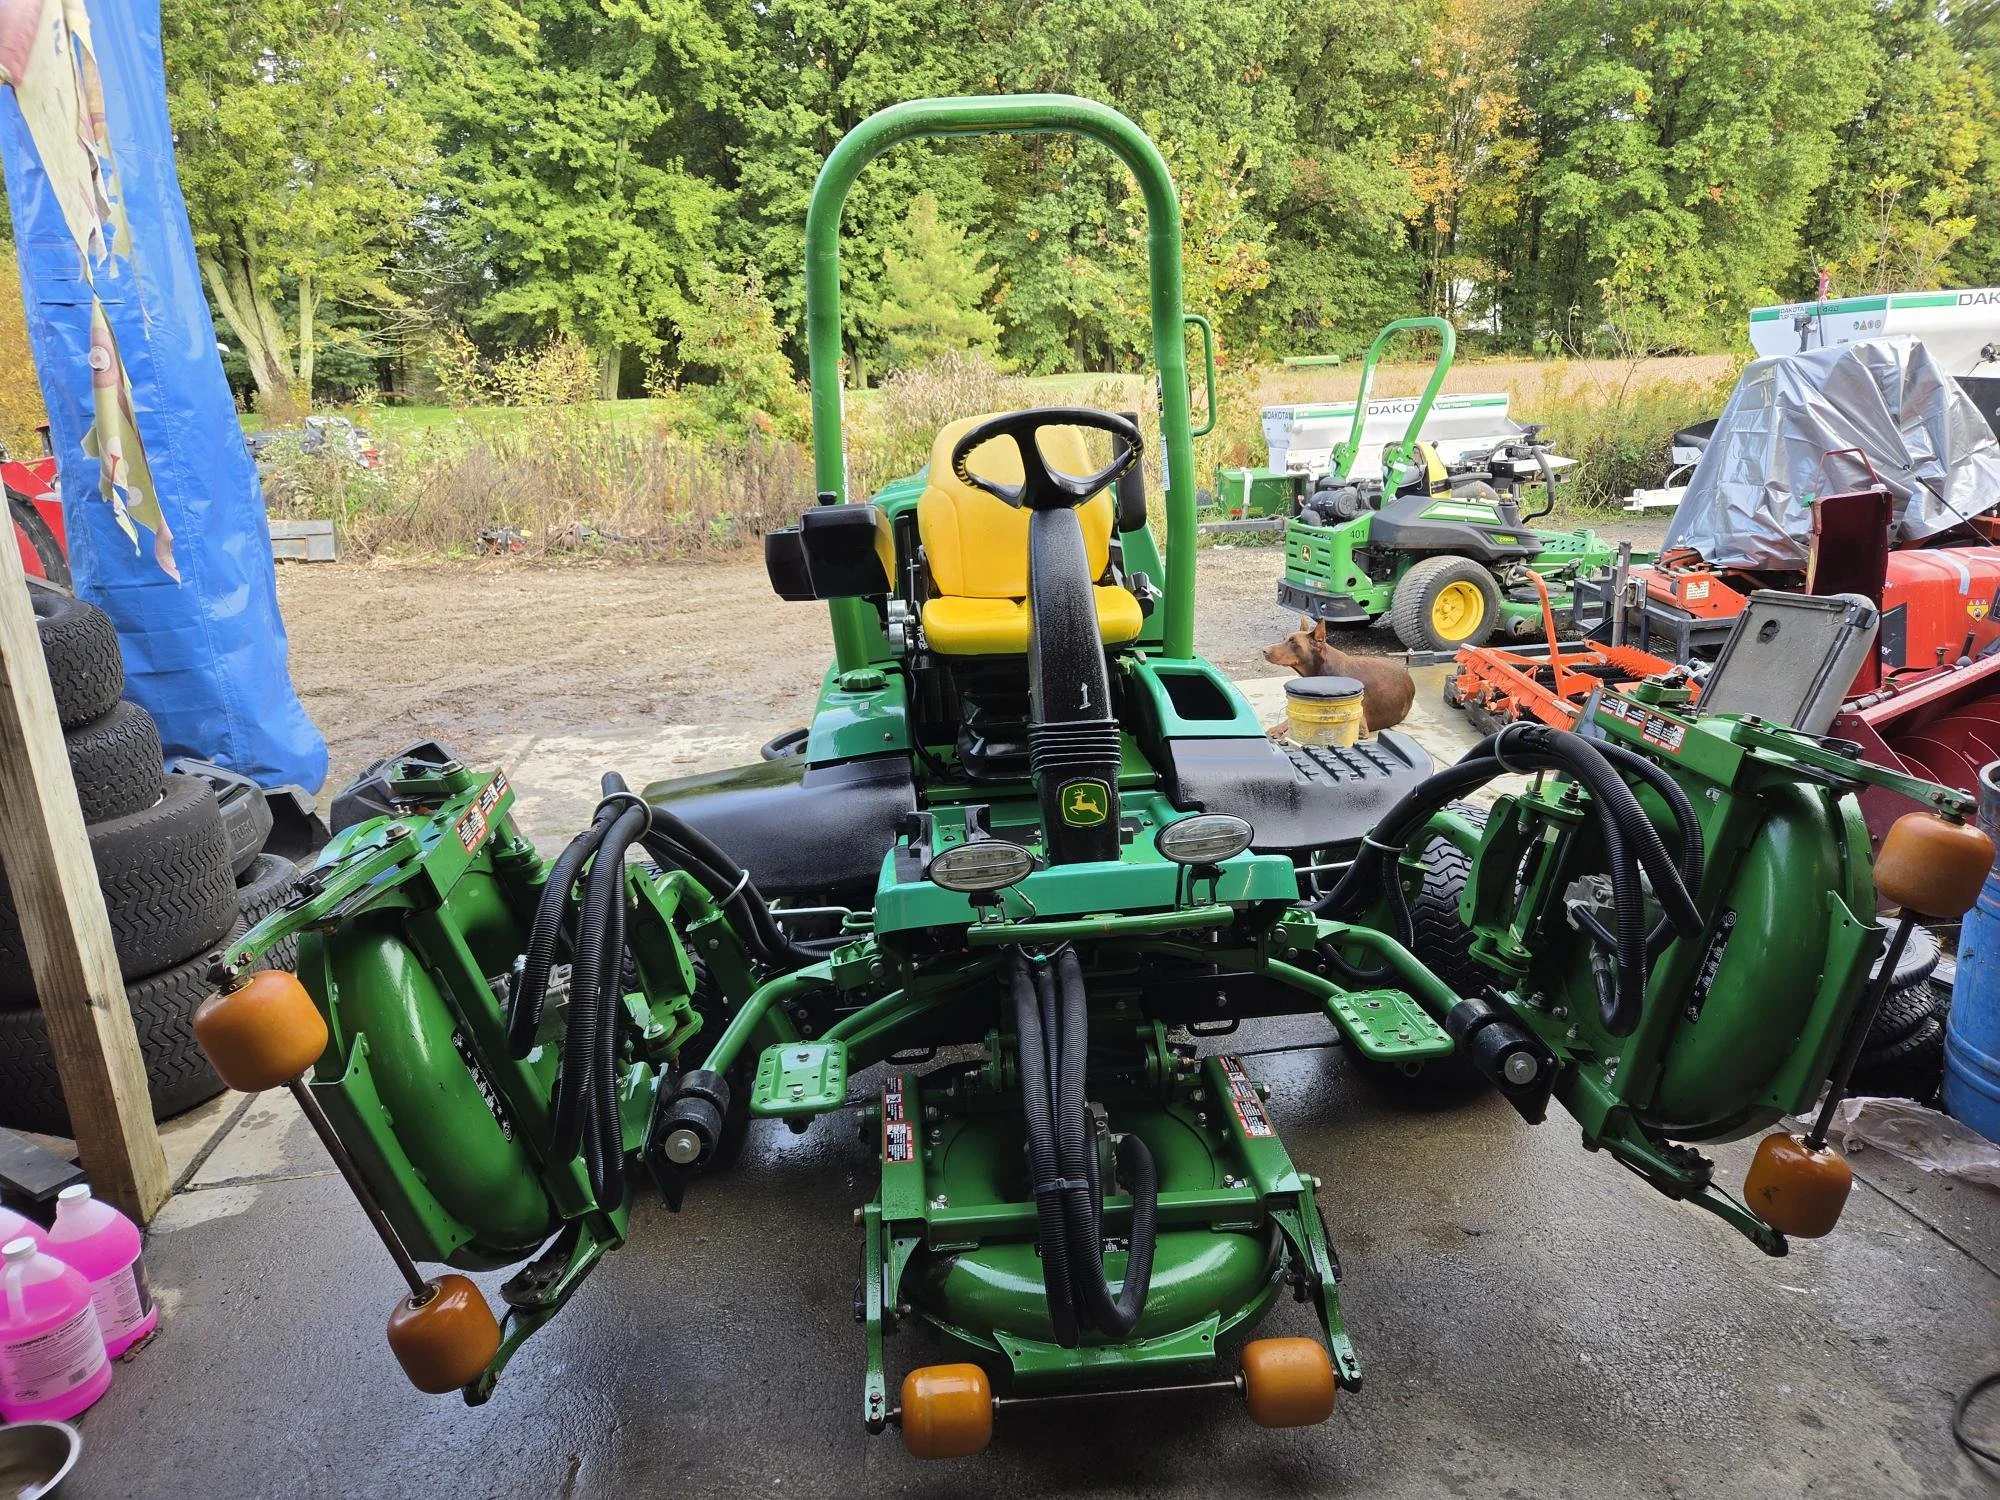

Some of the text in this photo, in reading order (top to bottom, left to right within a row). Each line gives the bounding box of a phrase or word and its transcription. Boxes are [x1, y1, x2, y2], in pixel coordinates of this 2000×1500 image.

[1780, 305, 1806, 314] DAKOTA
[1368, 403, 1436, 415] DAKO
[1266, 411, 1289, 420] DAKOTA
[1079, 682, 1091, 710] 1
